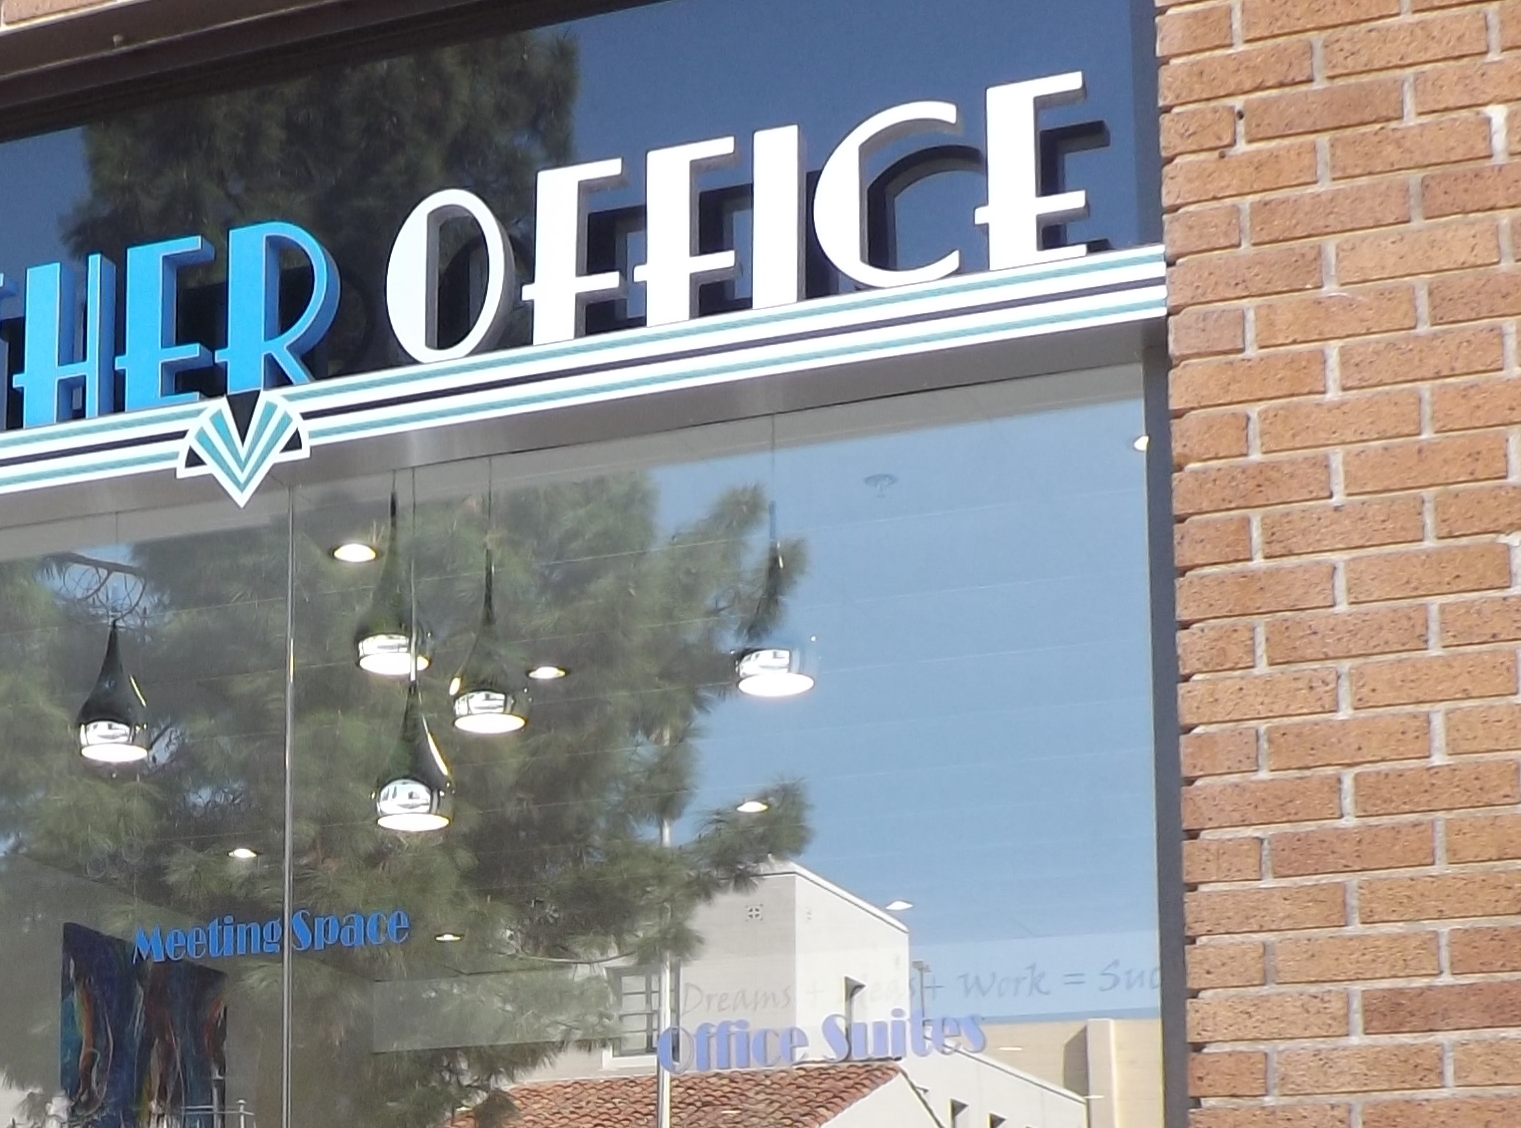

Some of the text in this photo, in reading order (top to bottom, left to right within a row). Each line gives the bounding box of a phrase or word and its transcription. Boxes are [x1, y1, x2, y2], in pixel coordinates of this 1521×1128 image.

[385, 71, 1089, 364] OFFICE
[132, 908, 411, 965] Meeting Space
[679, 981, 794, 1016] Dreams
[958, 962, 1051, 998] Work
[657, 1007, 987, 1075] Office Suites
